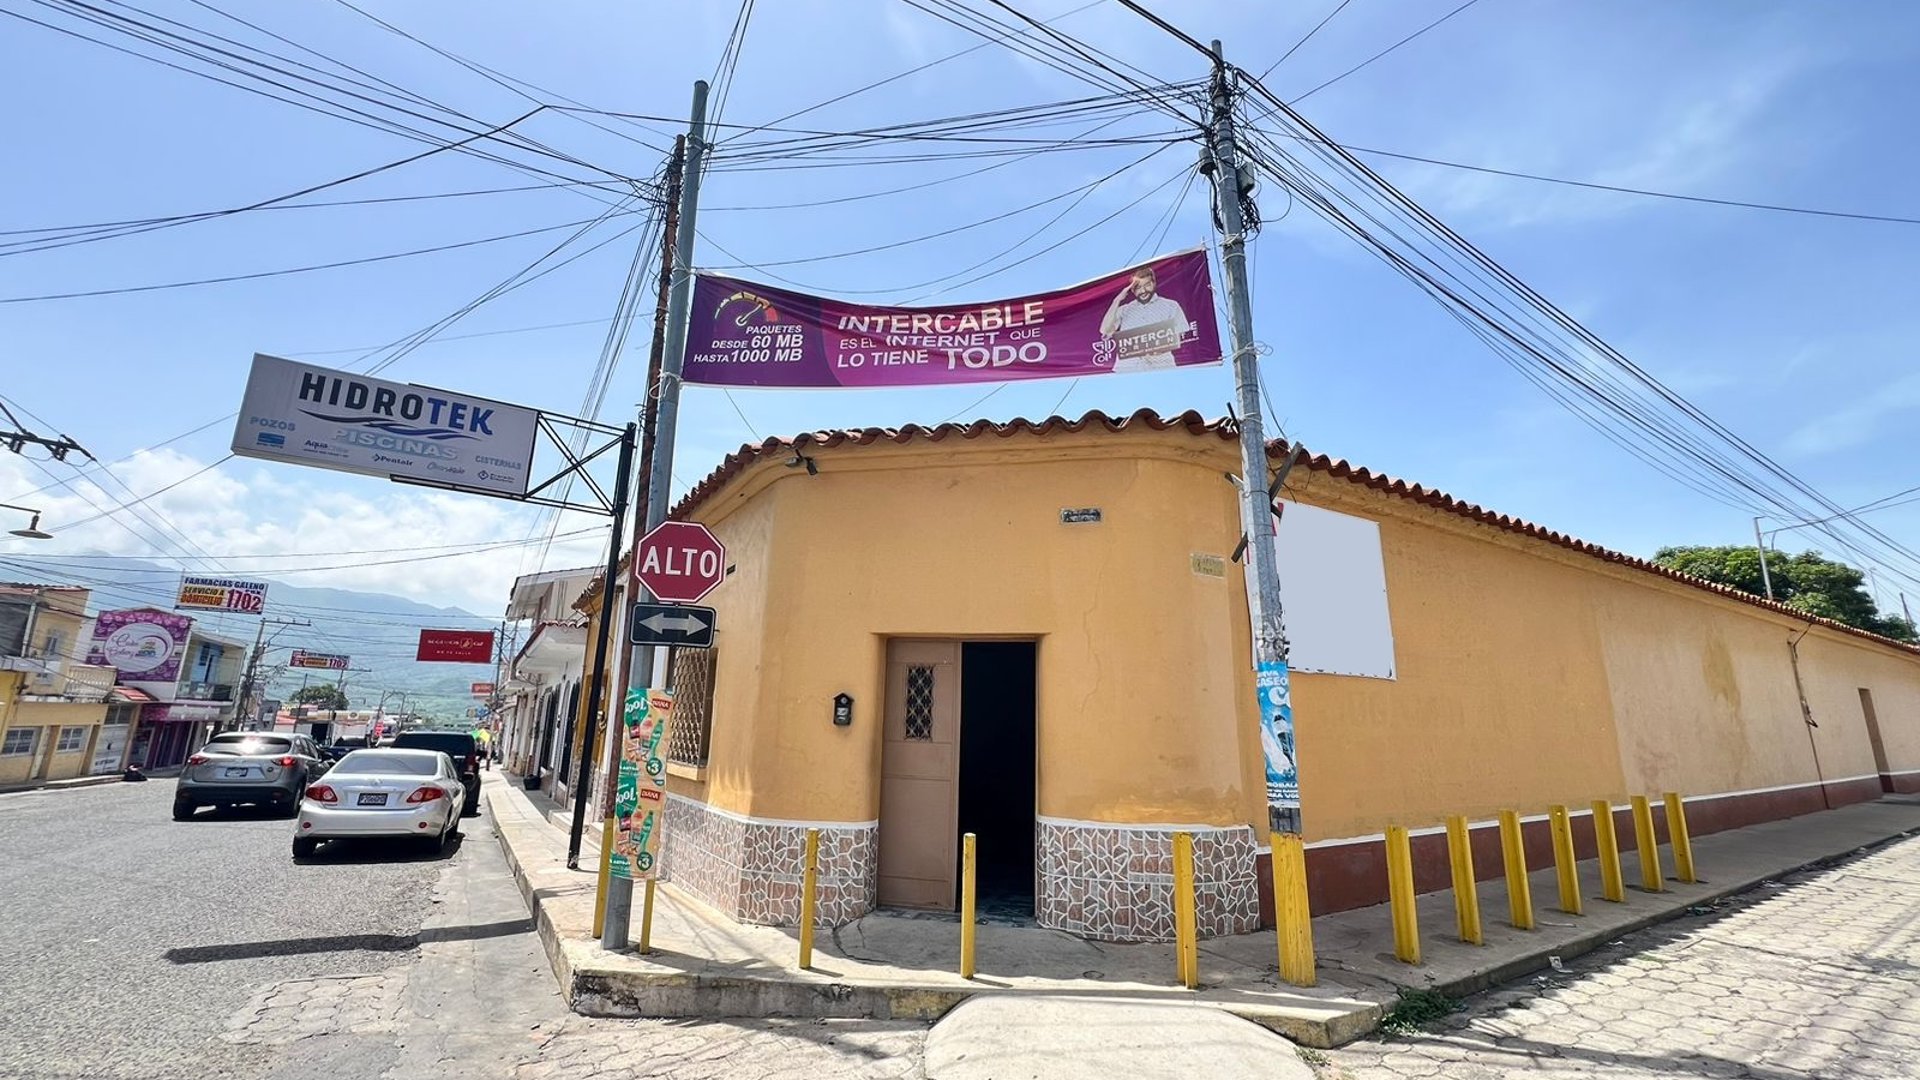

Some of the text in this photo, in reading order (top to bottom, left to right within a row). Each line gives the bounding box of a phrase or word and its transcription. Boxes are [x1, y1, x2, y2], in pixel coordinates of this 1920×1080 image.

[838, 301, 1044, 334] INTERCABLE
[746, 325, 802, 334] PAQUETES
[840, 327, 1041, 349] ES EL INTERNET QUE
[712, 334, 803, 349] DESDE 60 MB
[693, 348, 803, 362] HASTA 1000 MB
[837, 341, 1047, 370] LO TIENE TODO
[299, 372, 495, 436] HIDROTEK
[250, 416, 296, 431] POZOS
[331, 428, 458, 460] PISCINAS
[641, 545, 718, 578] ALTO
[183, 586, 225, 596] SERVICIO A
[184, 577, 265, 590] FARMACIAS GALENO
[227, 589, 262, 610] 1702
